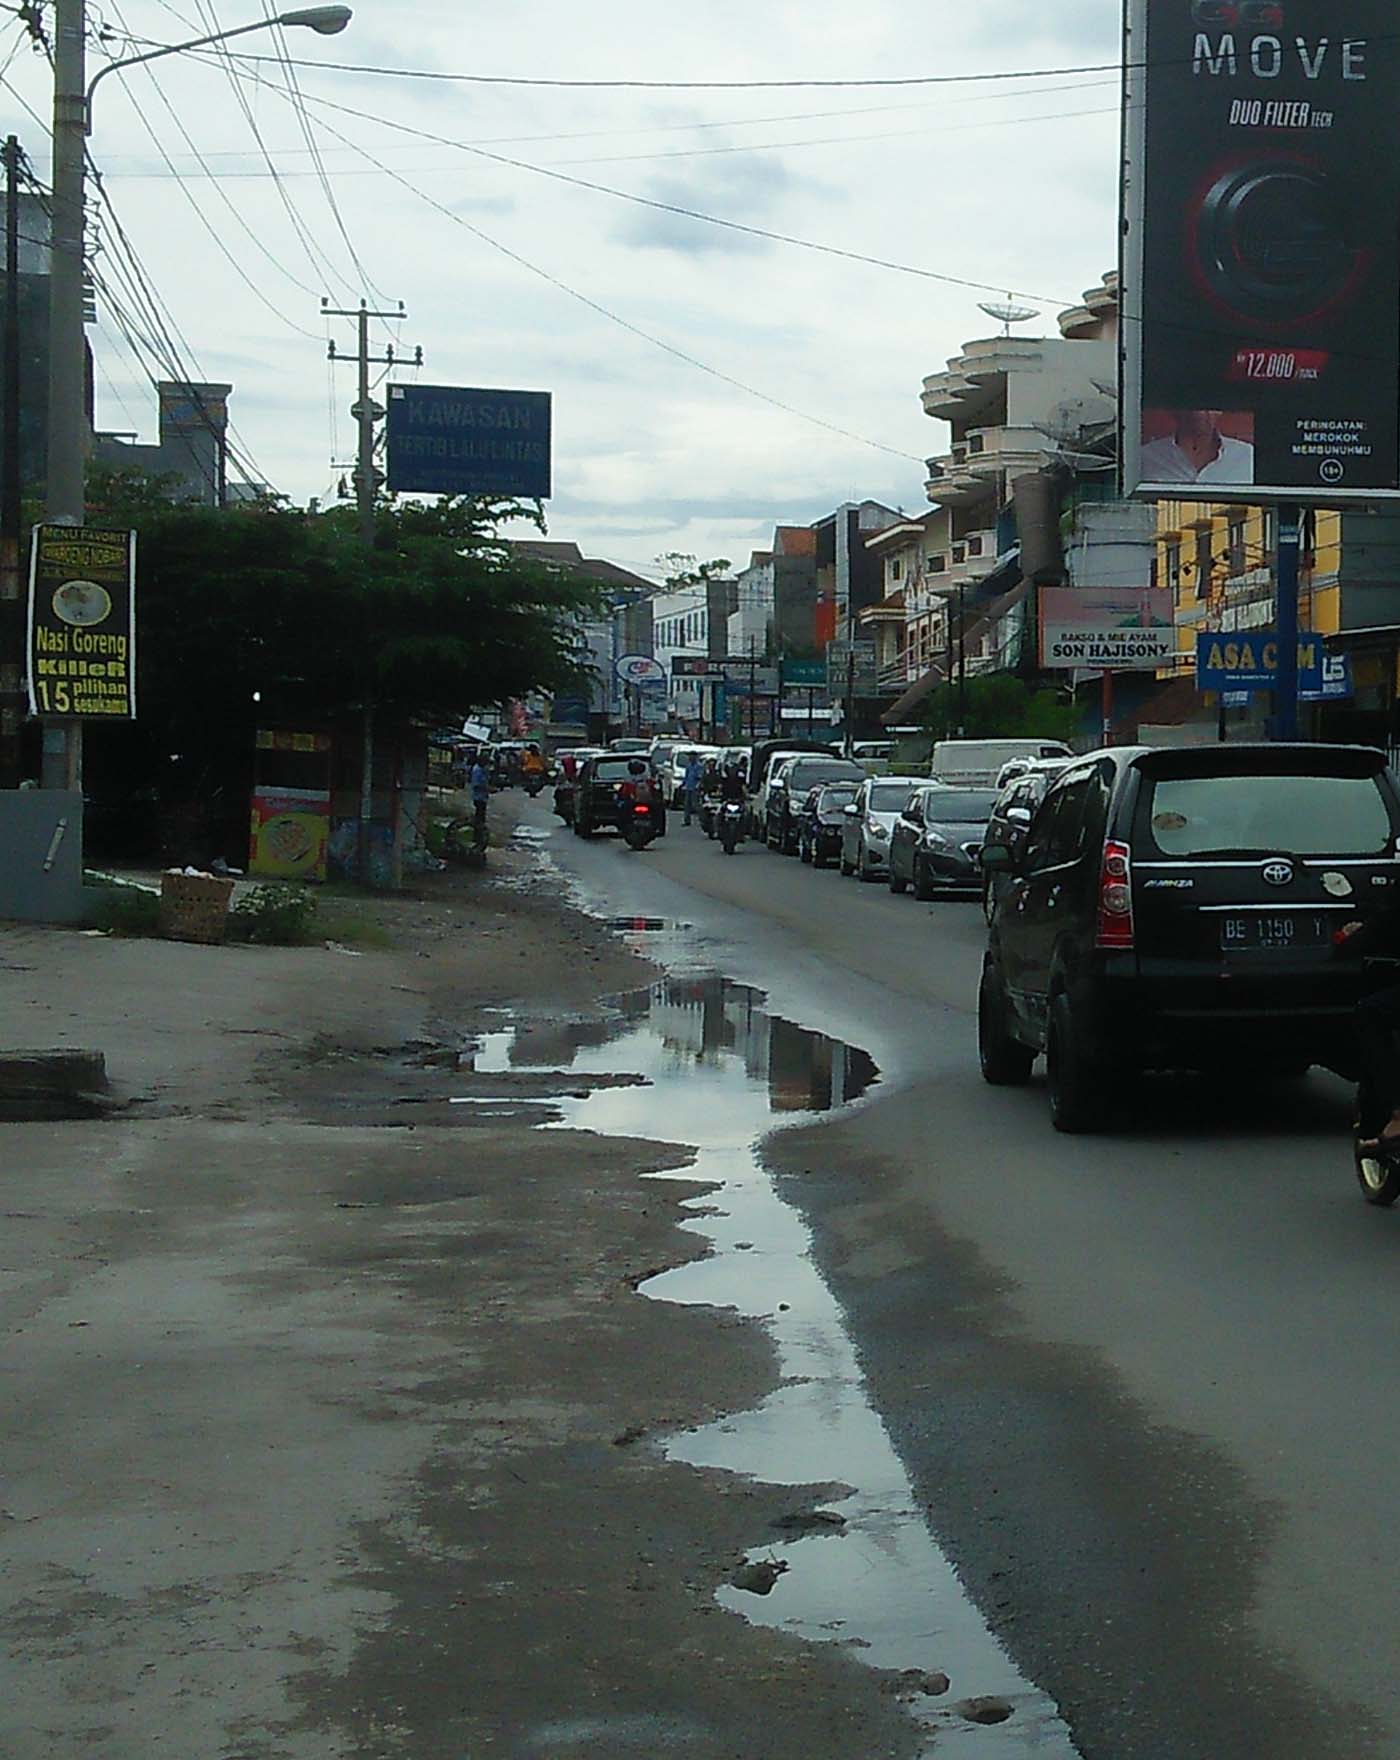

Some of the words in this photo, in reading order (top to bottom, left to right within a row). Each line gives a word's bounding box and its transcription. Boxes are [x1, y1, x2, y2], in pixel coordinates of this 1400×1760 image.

[1193, 33, 1366, 80] MOVE
[1229, 99, 1261, 125] DUO
[1264, 101, 1310, 127] FILTER
[1247, 352, 1295, 378] 12.000
[1303, 432, 1359, 442] MEROKOK
[36, 625, 69, 651] Nasi
[72, 627, 127, 660] Goreng
[1052, 643, 1086, 658] SON
[1206, 642, 1256, 670] ASA
[1262, 642, 1316, 670] CM
[37, 679, 70, 713] 15
[73, 679, 127, 696] pilihan
[1225, 919, 1246, 939] BE
[1257, 919, 1294, 938] 1150
